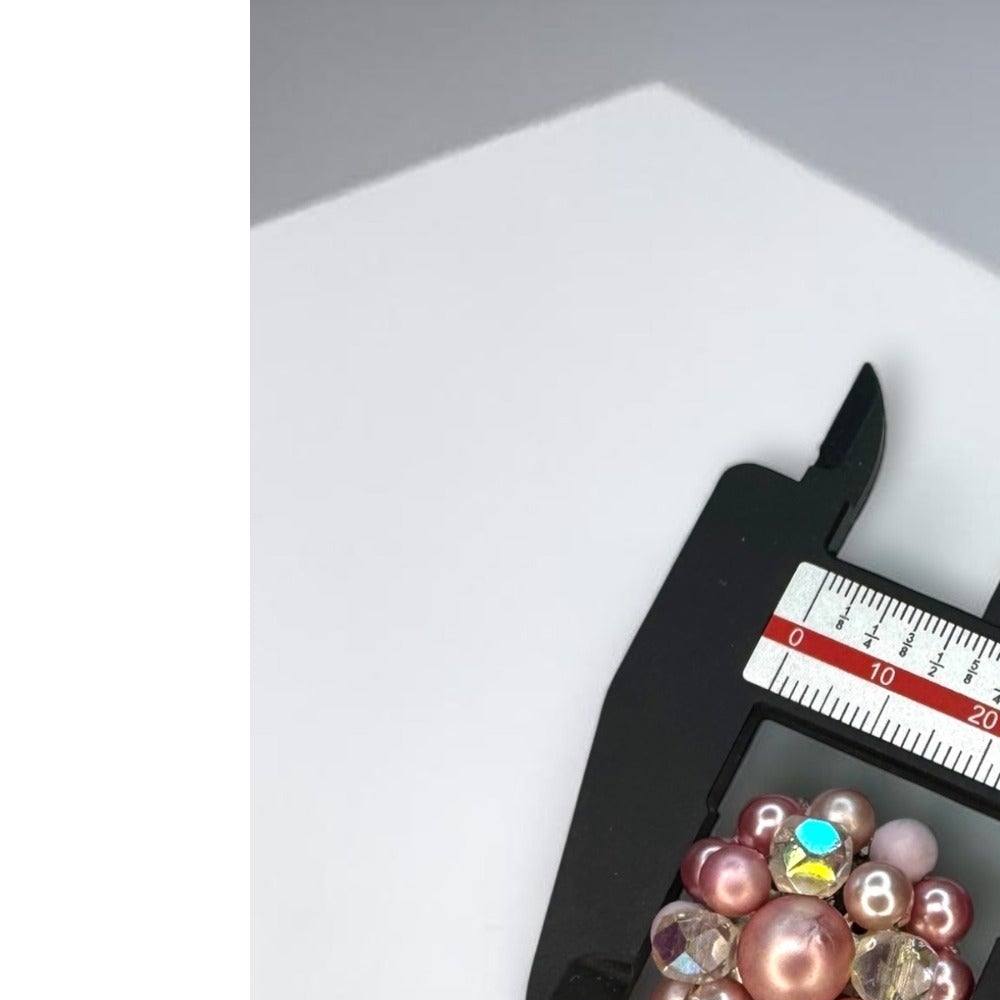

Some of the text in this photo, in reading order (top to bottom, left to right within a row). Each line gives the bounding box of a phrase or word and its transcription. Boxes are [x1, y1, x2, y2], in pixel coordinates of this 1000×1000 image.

[788, 628, 998, 730] 0 10 20
